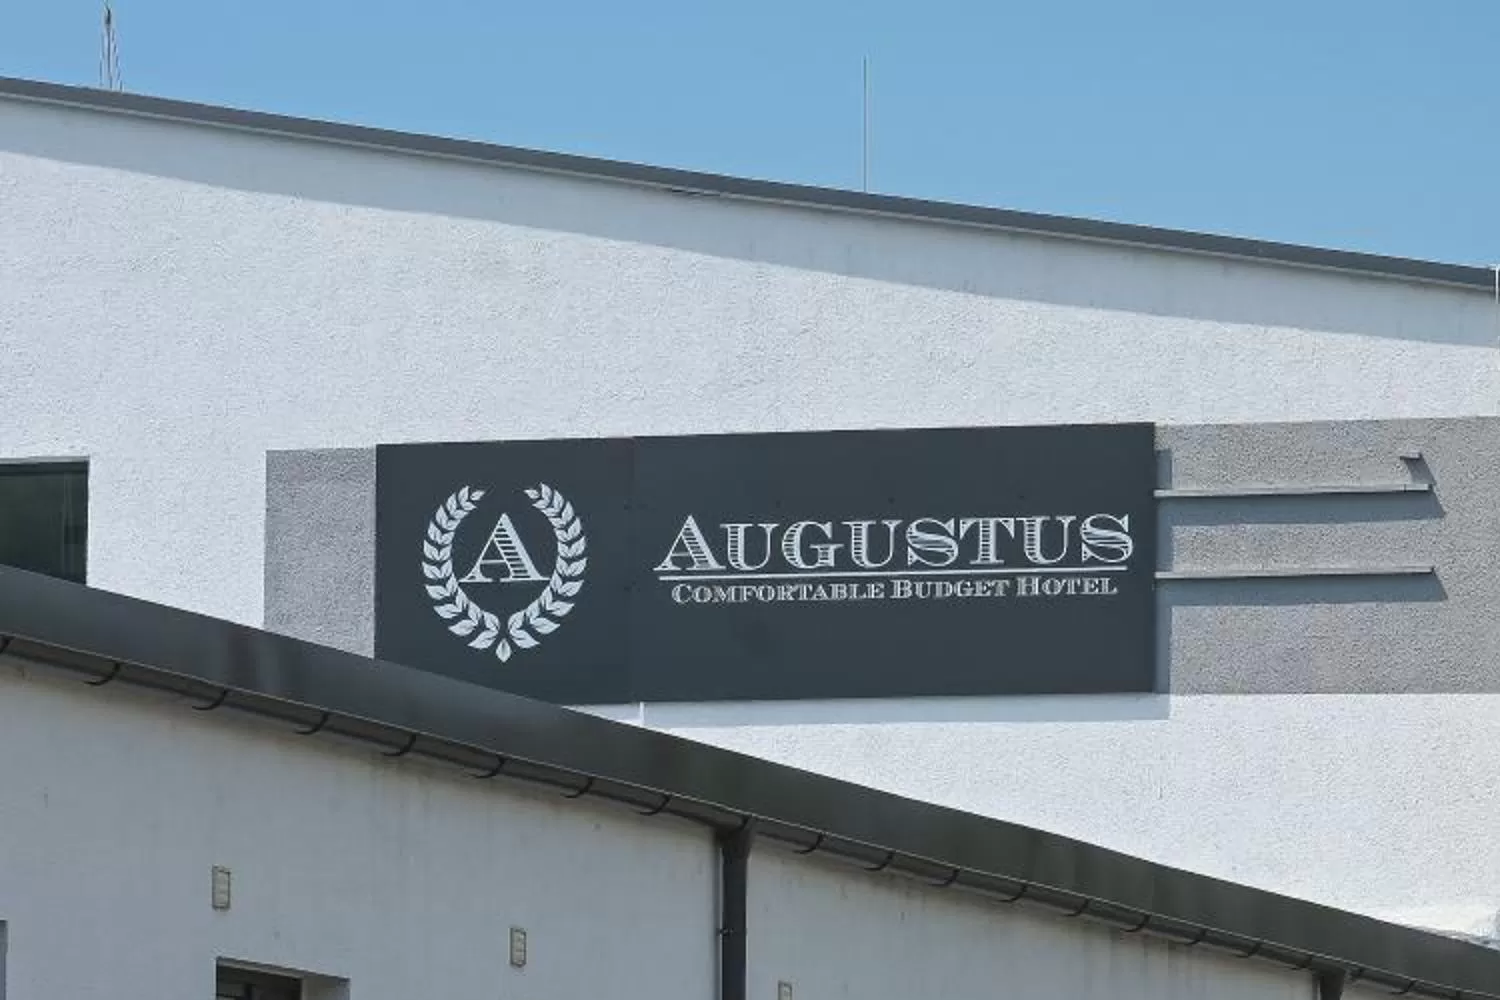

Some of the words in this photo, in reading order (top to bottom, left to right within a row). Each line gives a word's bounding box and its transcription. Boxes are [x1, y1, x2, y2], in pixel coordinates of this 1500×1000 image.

[460, 512, 550, 583] A
[653, 514, 1134, 572] AUGUSTUS
[671, 582, 885, 604] COMFORTABLE
[890, 579, 1010, 599] BUDGET
[1017, 576, 1118, 596] HOTEL
